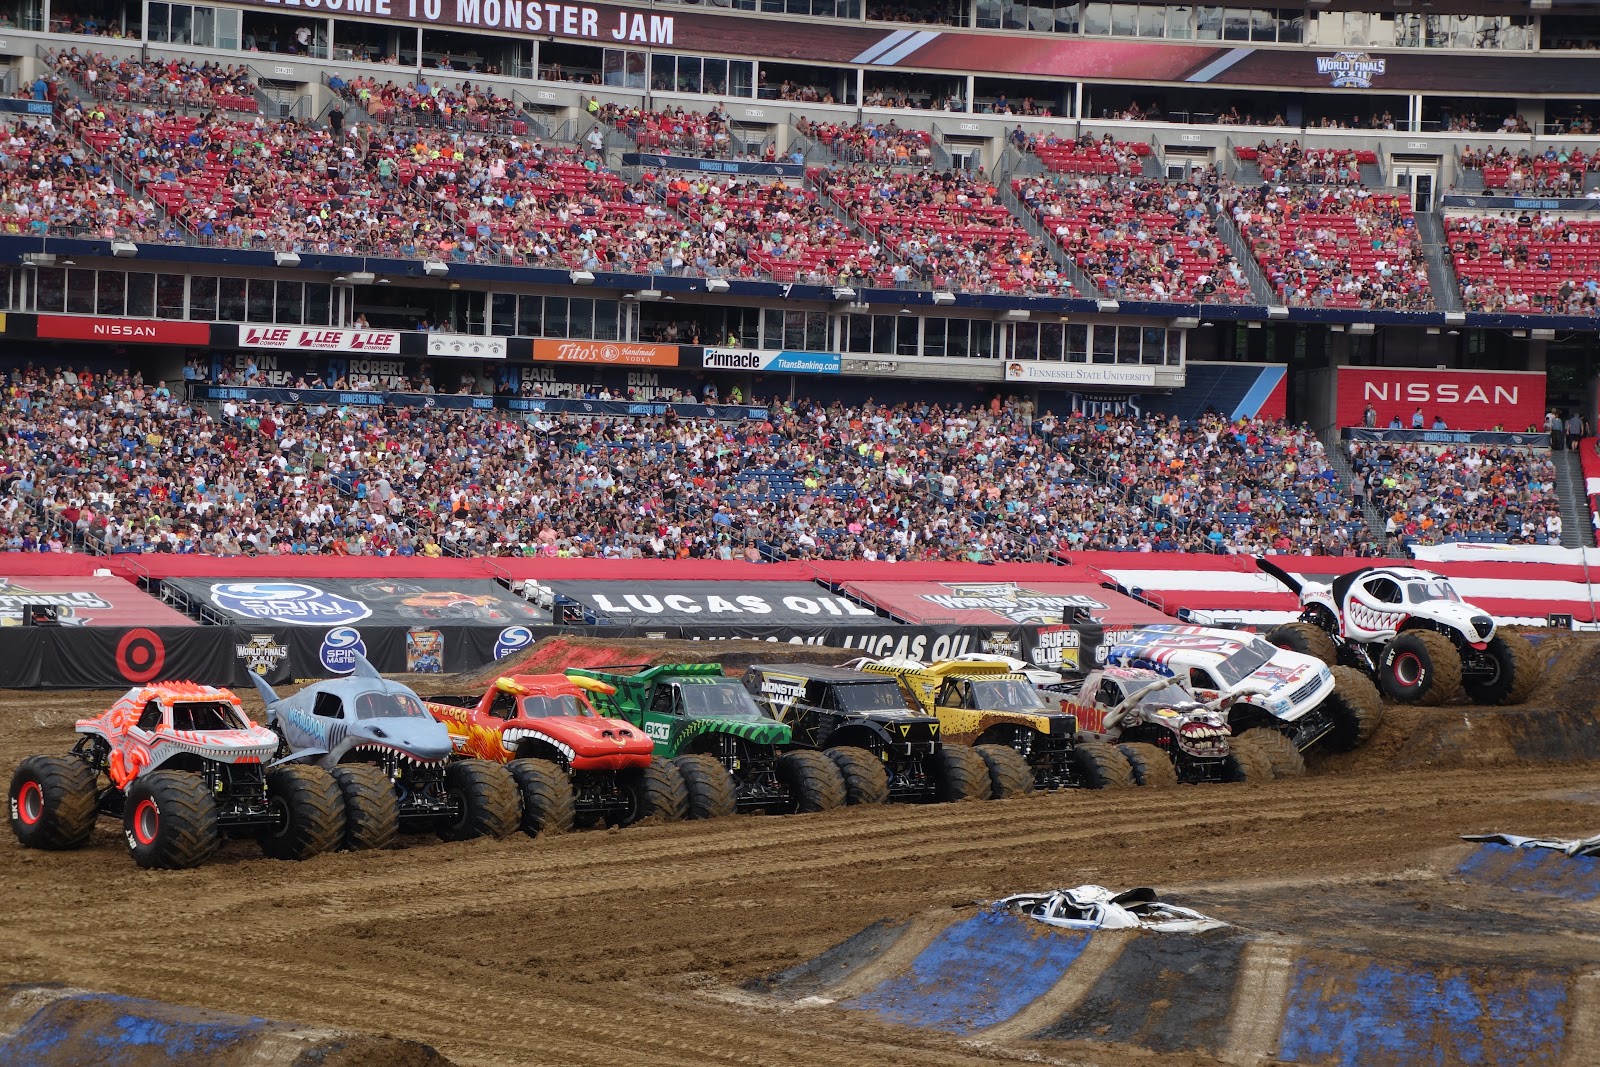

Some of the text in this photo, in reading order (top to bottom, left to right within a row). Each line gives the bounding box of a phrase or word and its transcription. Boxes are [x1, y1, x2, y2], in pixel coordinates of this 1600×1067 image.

[456, 0, 598, 37] MONSTER
[611, 12, 674, 44] JAM
[1318, 58, 1385, 73] WORLD FINALS
[1514, 200, 1541, 208] TENNESSEE
[94, 324, 156, 337] NISSAN
[262, 328, 291, 341] LEE
[314, 331, 343, 343] LEE
[365, 333, 394, 346] LEE
[557, 342, 598, 361] Tito's
[621, 346, 656, 357] Handmade
[625, 355, 651, 363] VODKA
[705, 349, 760, 368] Pinnacle
[349, 359, 406, 375] ROBERT
[778, 358, 839, 372] TitansBanking.com
[521, 367, 557, 382] EARL
[627, 372, 659, 387] BUM
[1364, 381, 1518, 405] NISSAN
[591, 594, 876, 616] LUCAS OIL
[1041, 630, 1079, 648] SUPER
[237, 645, 286, 657] WORLD FINALS
[1034, 647, 1063, 664] GLUE
[1386, 648, 1396, 666] BKT
[761, 681, 807, 698] MONSTER
[770, 693, 793, 705] JAM
[646, 723, 669, 737] BKT
[11, 797, 19, 820] BKT
[125, 829, 137, 850] BKT
